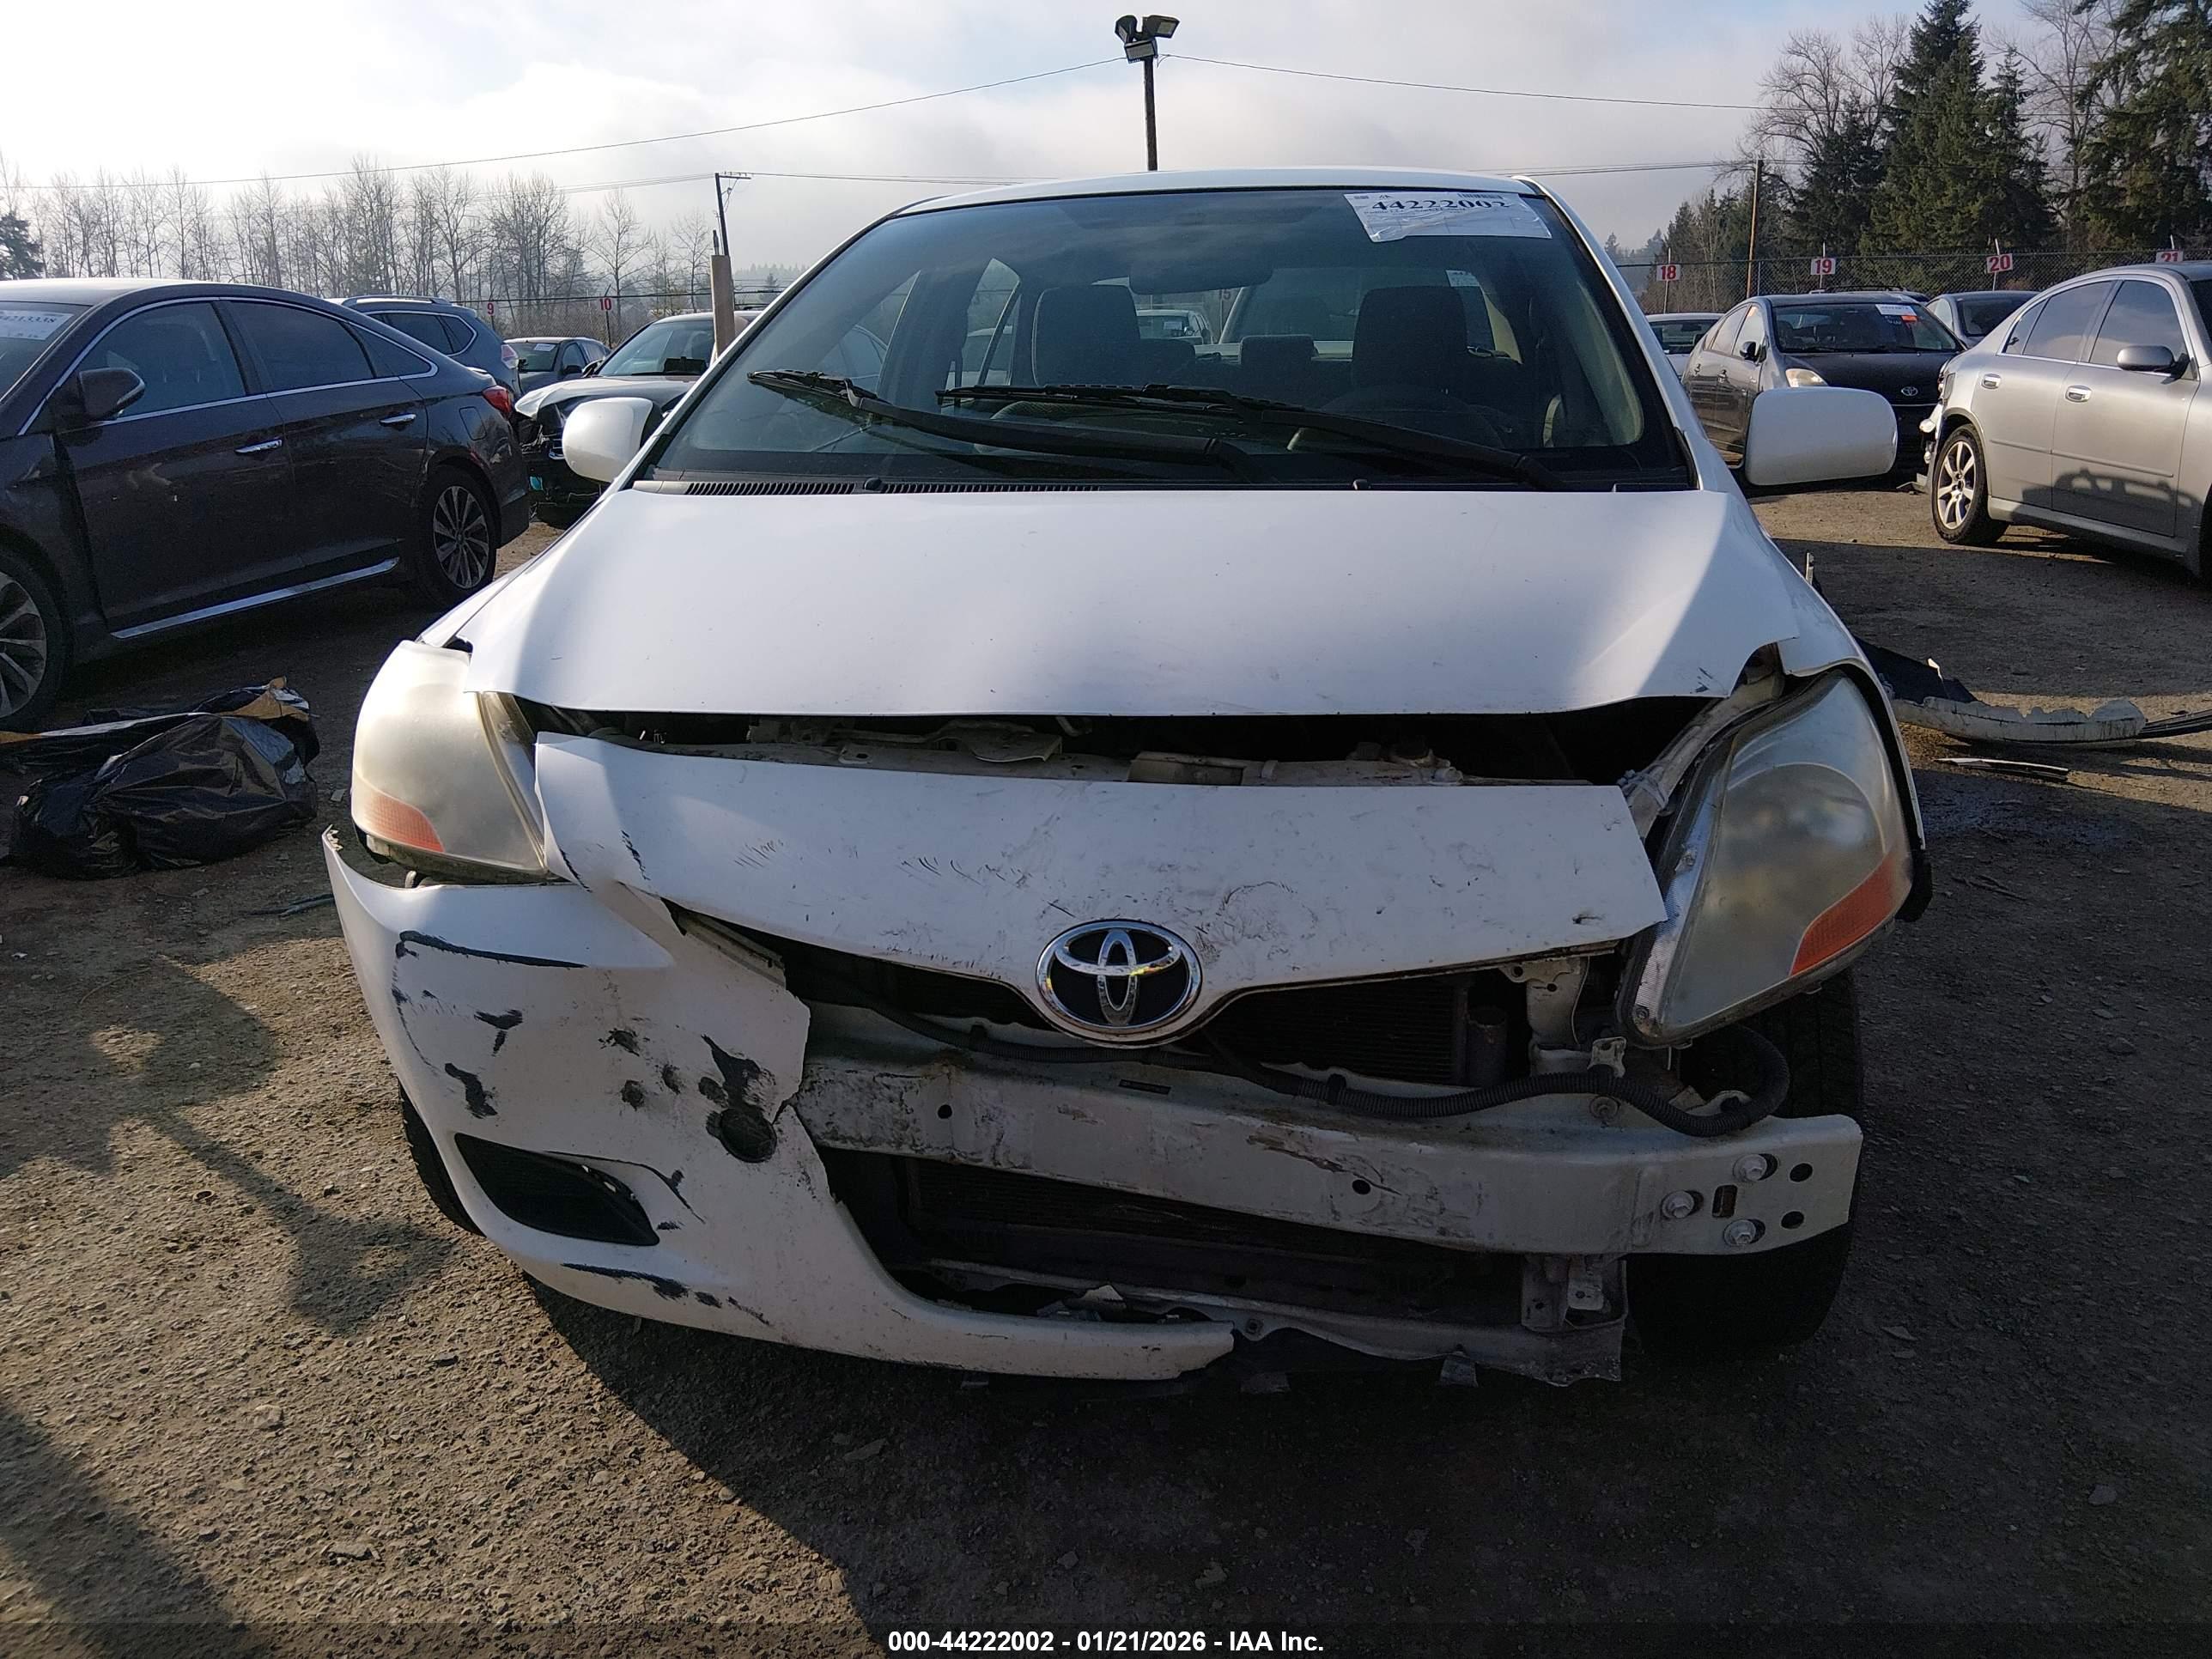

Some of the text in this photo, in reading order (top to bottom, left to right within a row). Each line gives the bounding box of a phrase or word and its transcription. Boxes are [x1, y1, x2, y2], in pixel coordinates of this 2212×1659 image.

[1372, 199, 1511, 210] 44222002
[1815, 258, 1832, 274] 19
[1989, 254, 2011, 272] 20
[1661, 264, 1677, 280] 18
[487, 302, 495, 315] 9
[600, 297, 612, 311] 10
